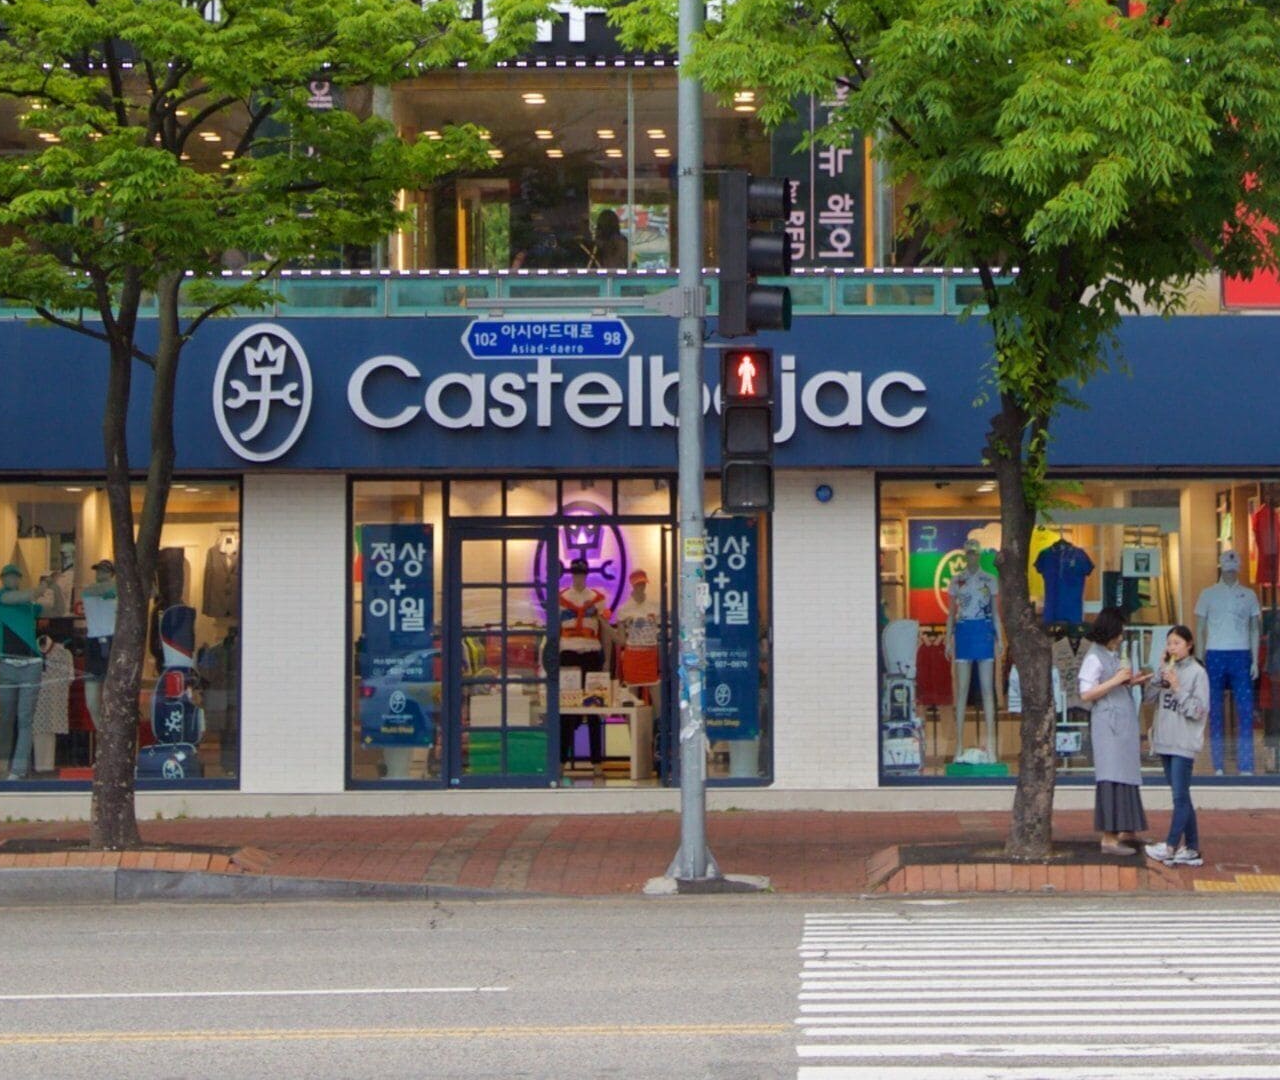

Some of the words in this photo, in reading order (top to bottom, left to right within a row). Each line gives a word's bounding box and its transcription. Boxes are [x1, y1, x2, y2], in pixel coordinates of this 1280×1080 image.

[474, 332, 498, 347] 102
[501, 323, 594, 339] 아시아드대로
[603, 331, 622, 346] 98
[511, 343, 585, 354] Asiad-daero
[370, 542, 426, 578] 정상
[369, 597, 426, 632] 이월
